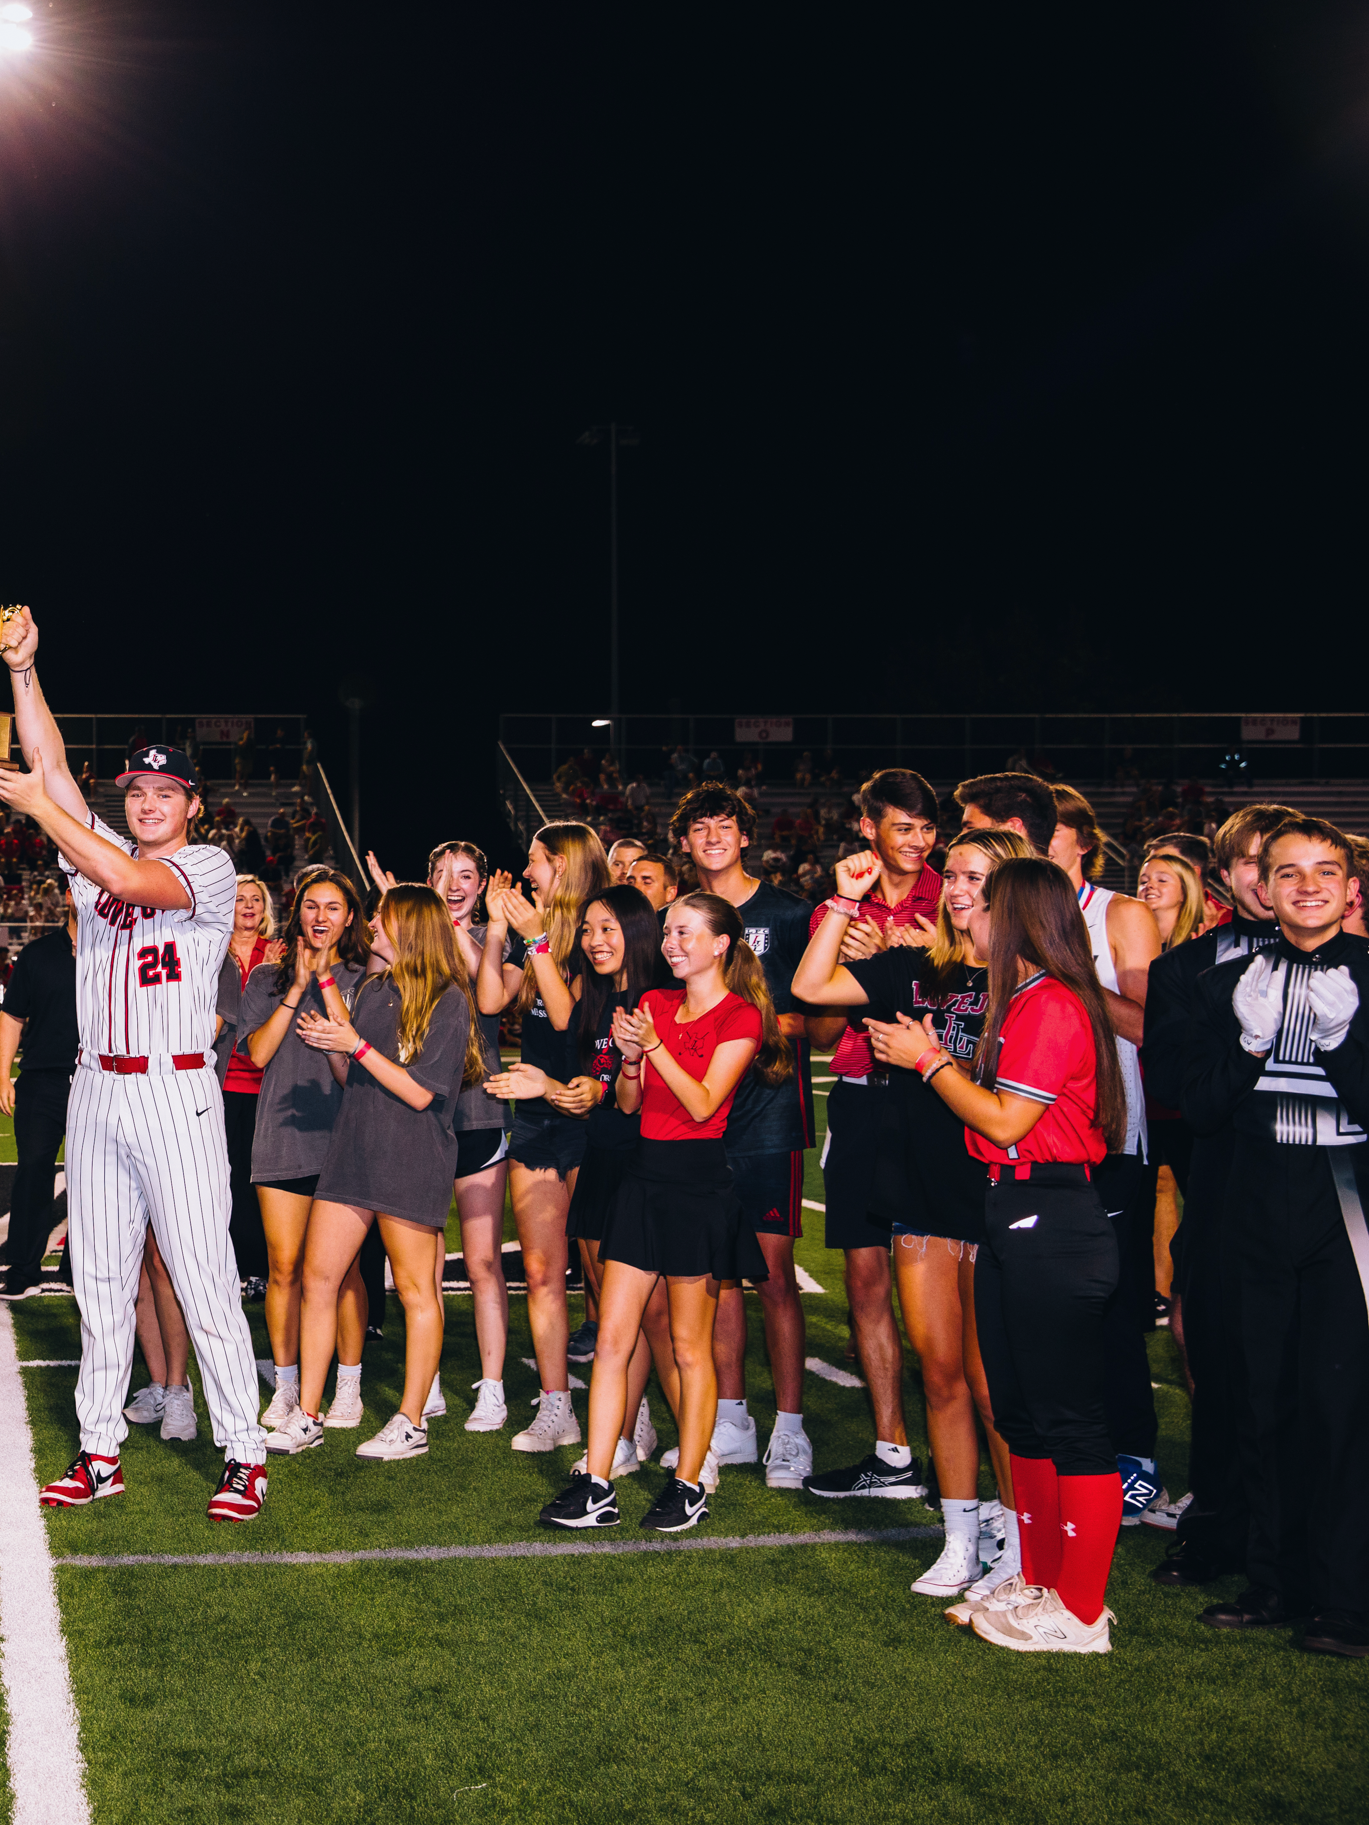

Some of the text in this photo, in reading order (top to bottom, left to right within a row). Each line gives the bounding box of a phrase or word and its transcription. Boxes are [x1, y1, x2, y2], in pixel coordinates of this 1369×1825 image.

[197, 720, 252, 729] SECTION
[736, 720, 791, 729] SECTION
[1243, 718, 1298, 727] SECTION
[219, 729, 231, 740] N
[758, 729, 770, 741] O
[1265, 727, 1275, 739] P
[137, 941, 181, 987] 24
